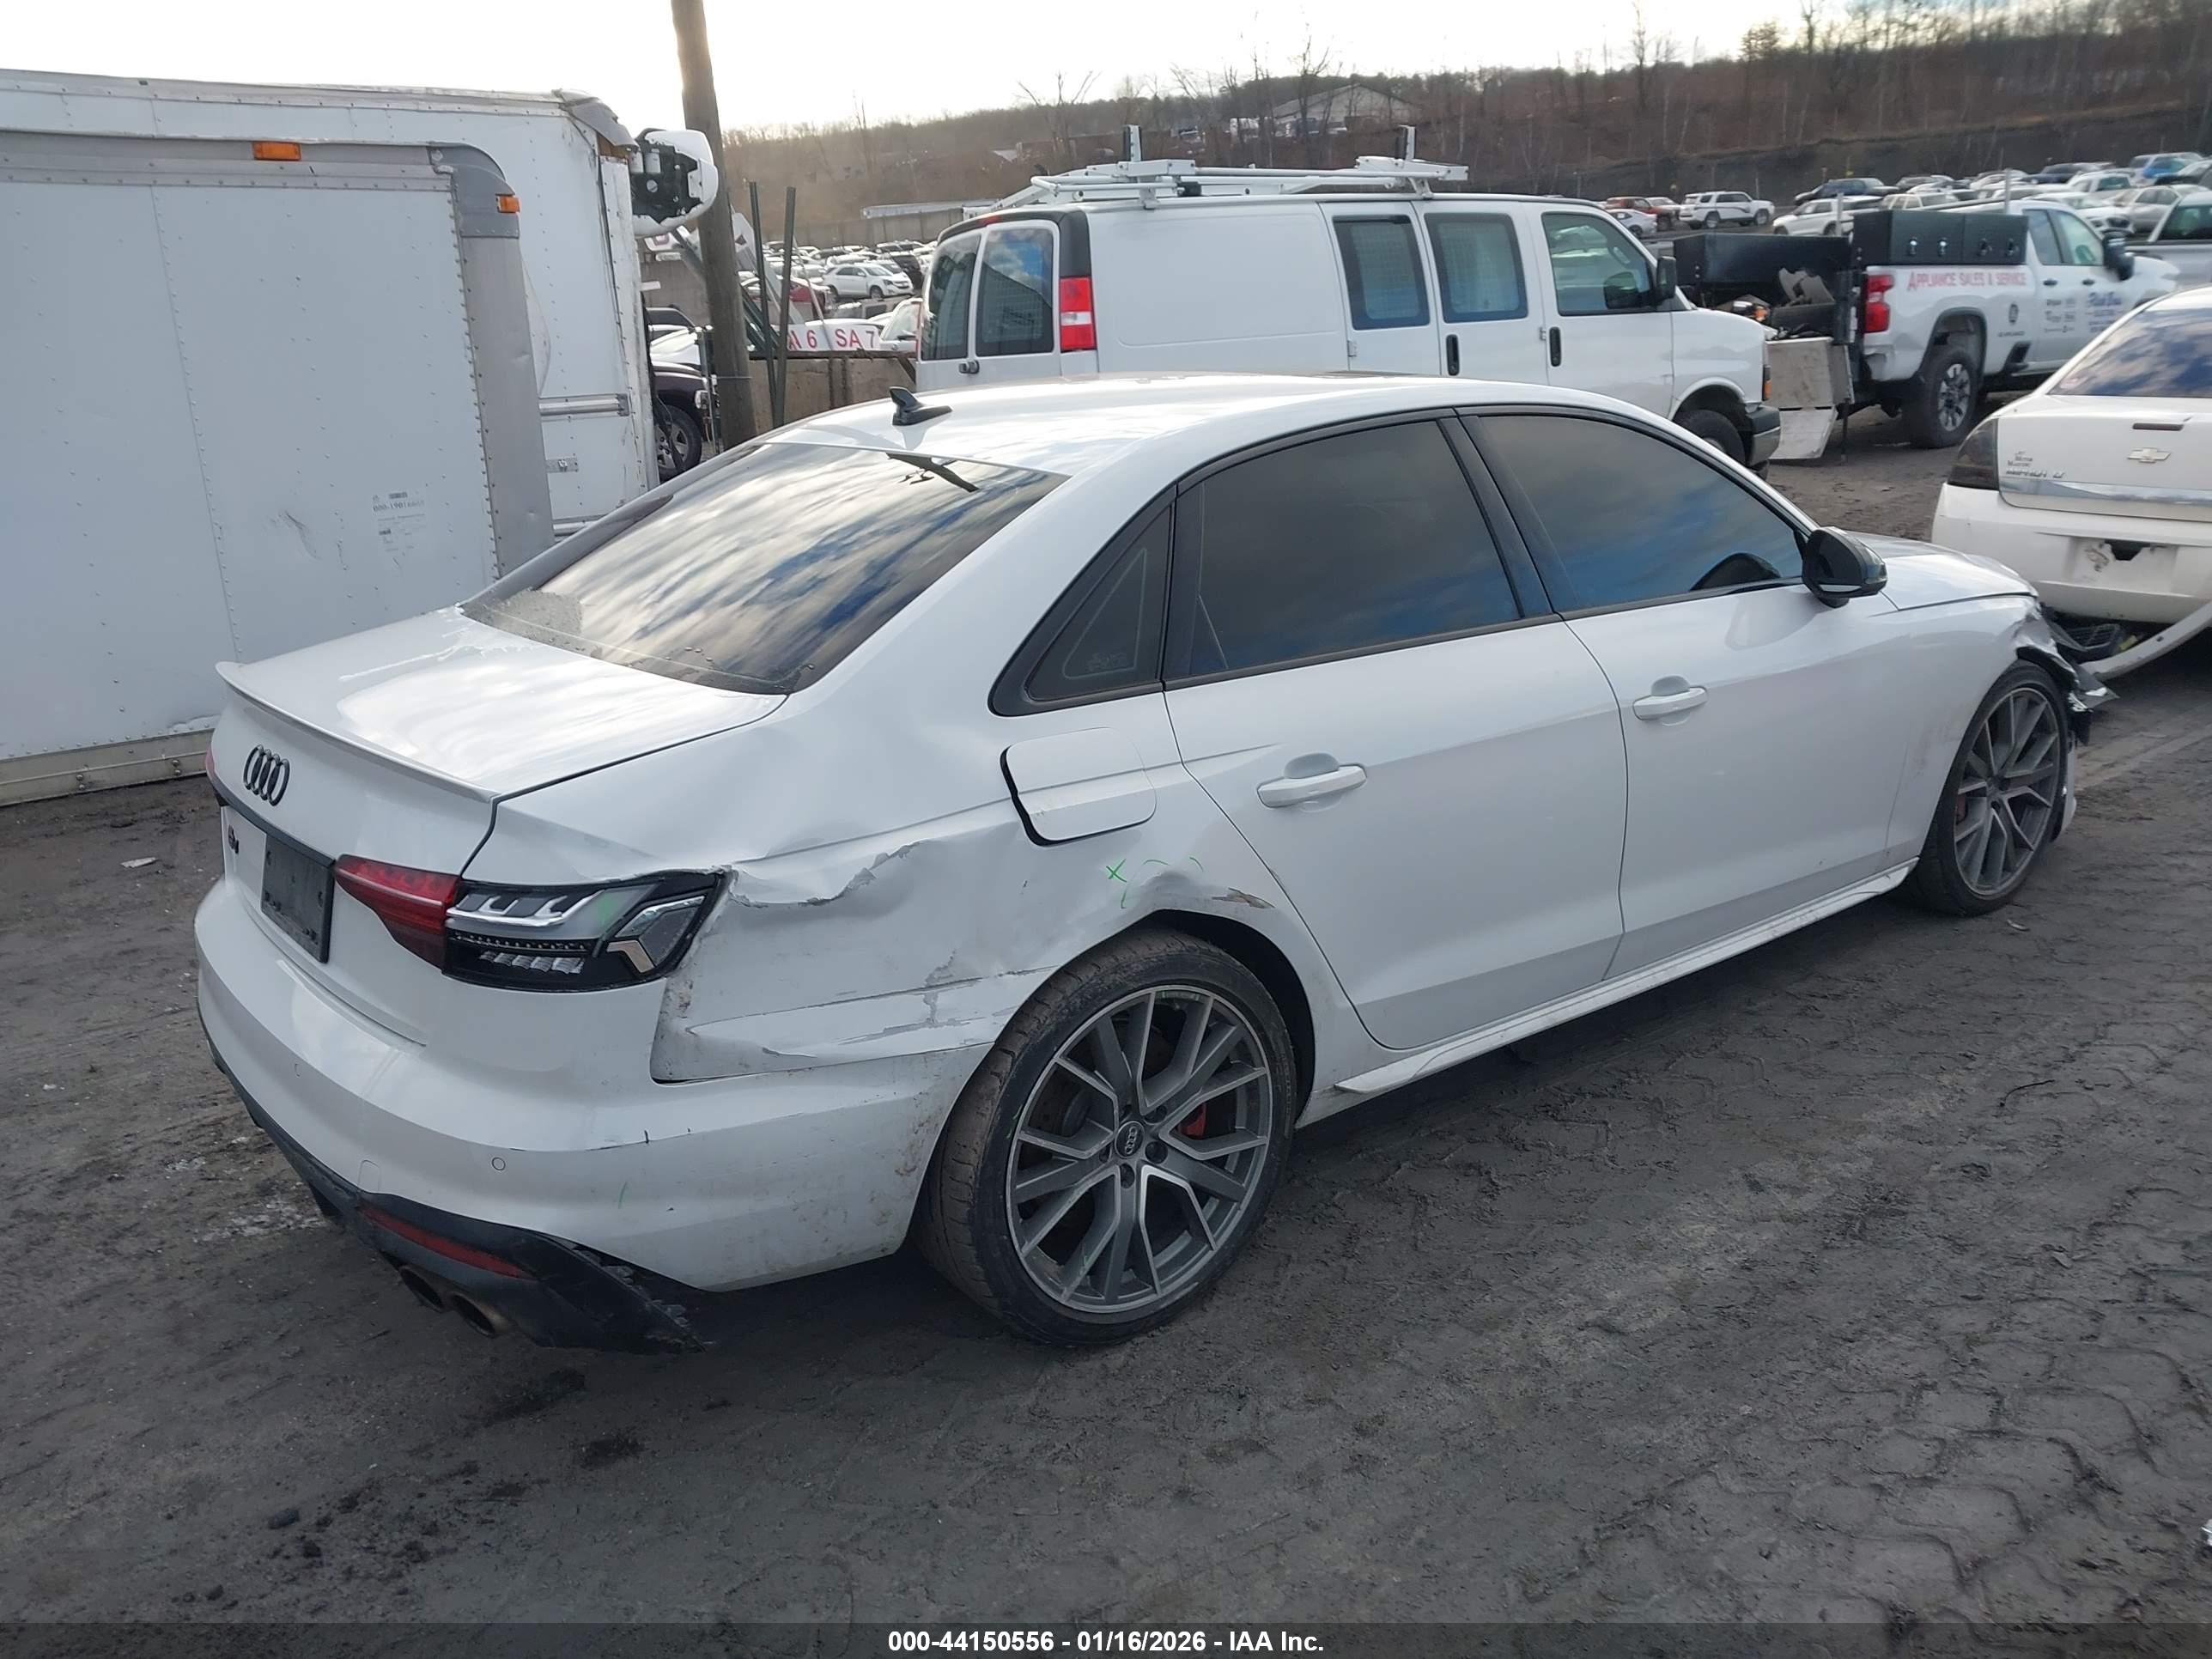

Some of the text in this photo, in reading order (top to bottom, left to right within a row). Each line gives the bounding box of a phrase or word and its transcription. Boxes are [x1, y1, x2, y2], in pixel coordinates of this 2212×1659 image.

[1908, 271, 1957, 290] APPLIANCE
[1960, 271, 1985, 286] SALES
[1996, 271, 2027, 286] SERVICE
[834, 328, 862, 349] SA
